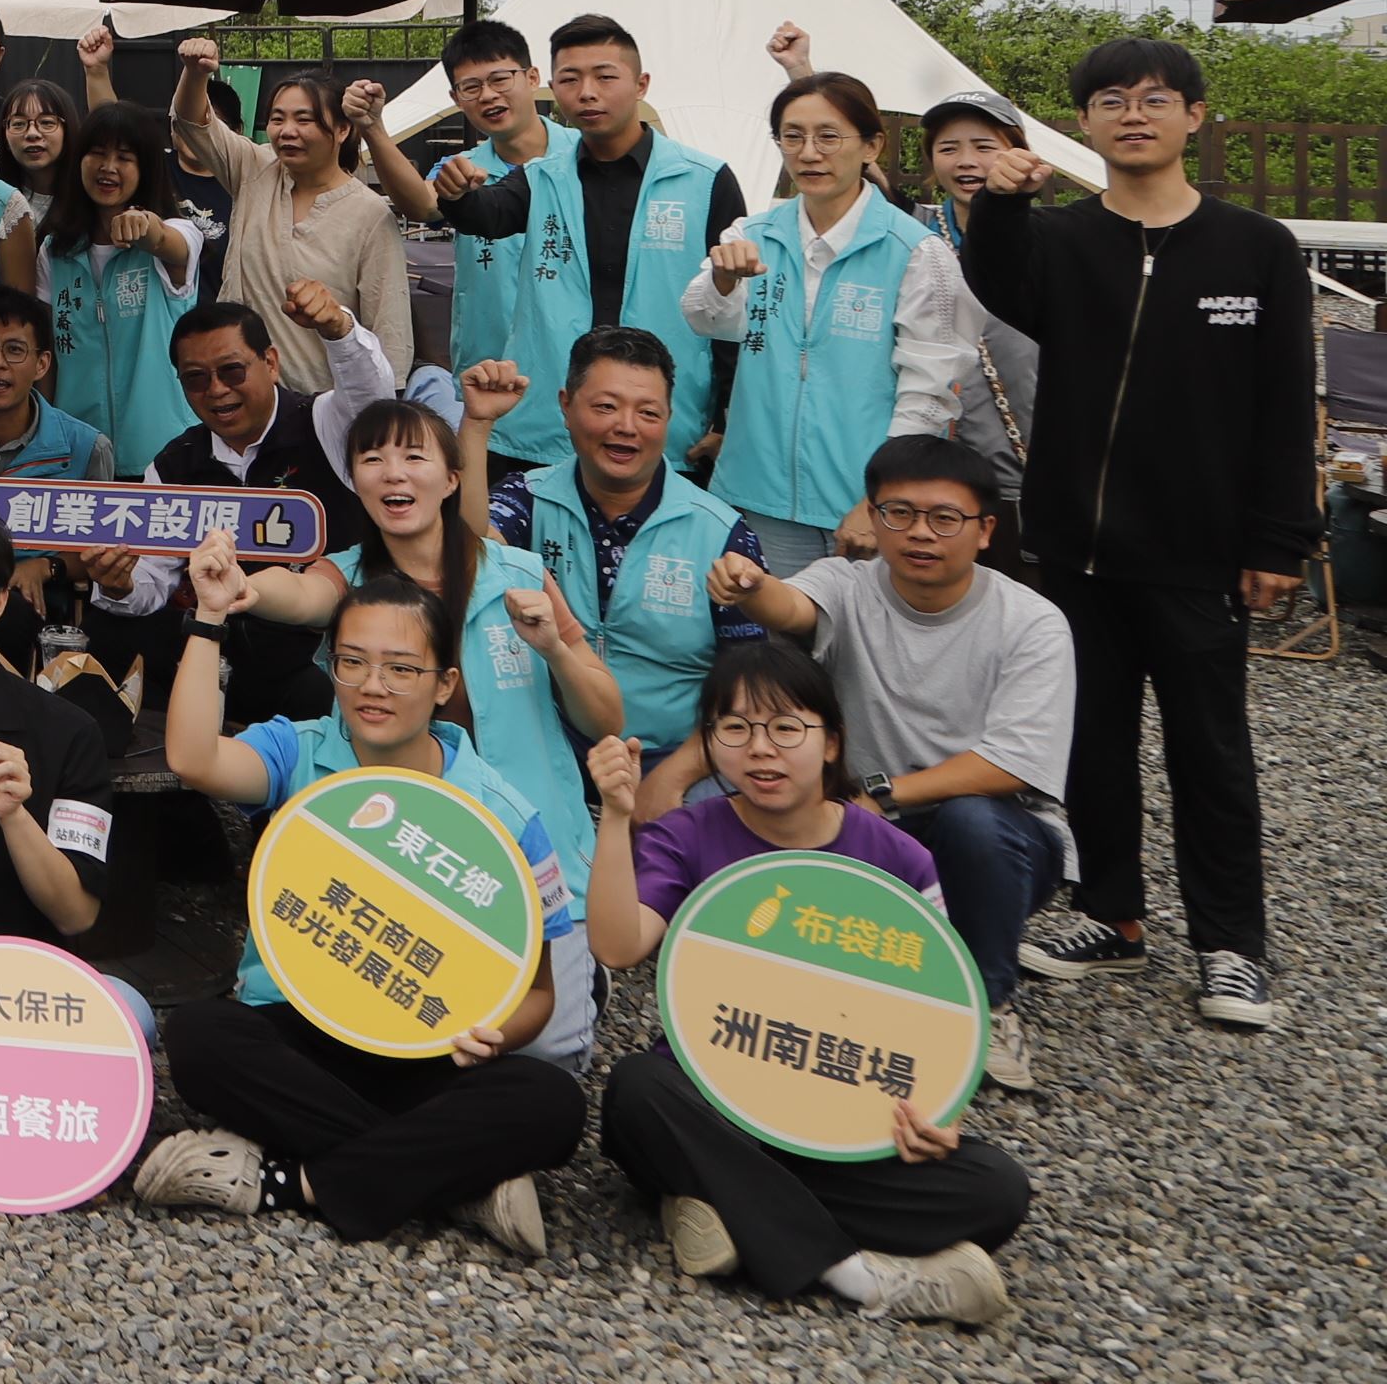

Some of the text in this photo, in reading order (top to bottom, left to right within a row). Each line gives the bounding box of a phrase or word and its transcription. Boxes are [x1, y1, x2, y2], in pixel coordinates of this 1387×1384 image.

[5, 490, 242, 542] 創業不設限
[387, 818, 506, 912] 東石鄉
[271, 887, 452, 1032] 觀光發展協會
[317, 876, 444, 981] 東石商圈
[790, 904, 927, 974] 布袋鎮
[711, 1000, 918, 1100] 洲南鹽場
